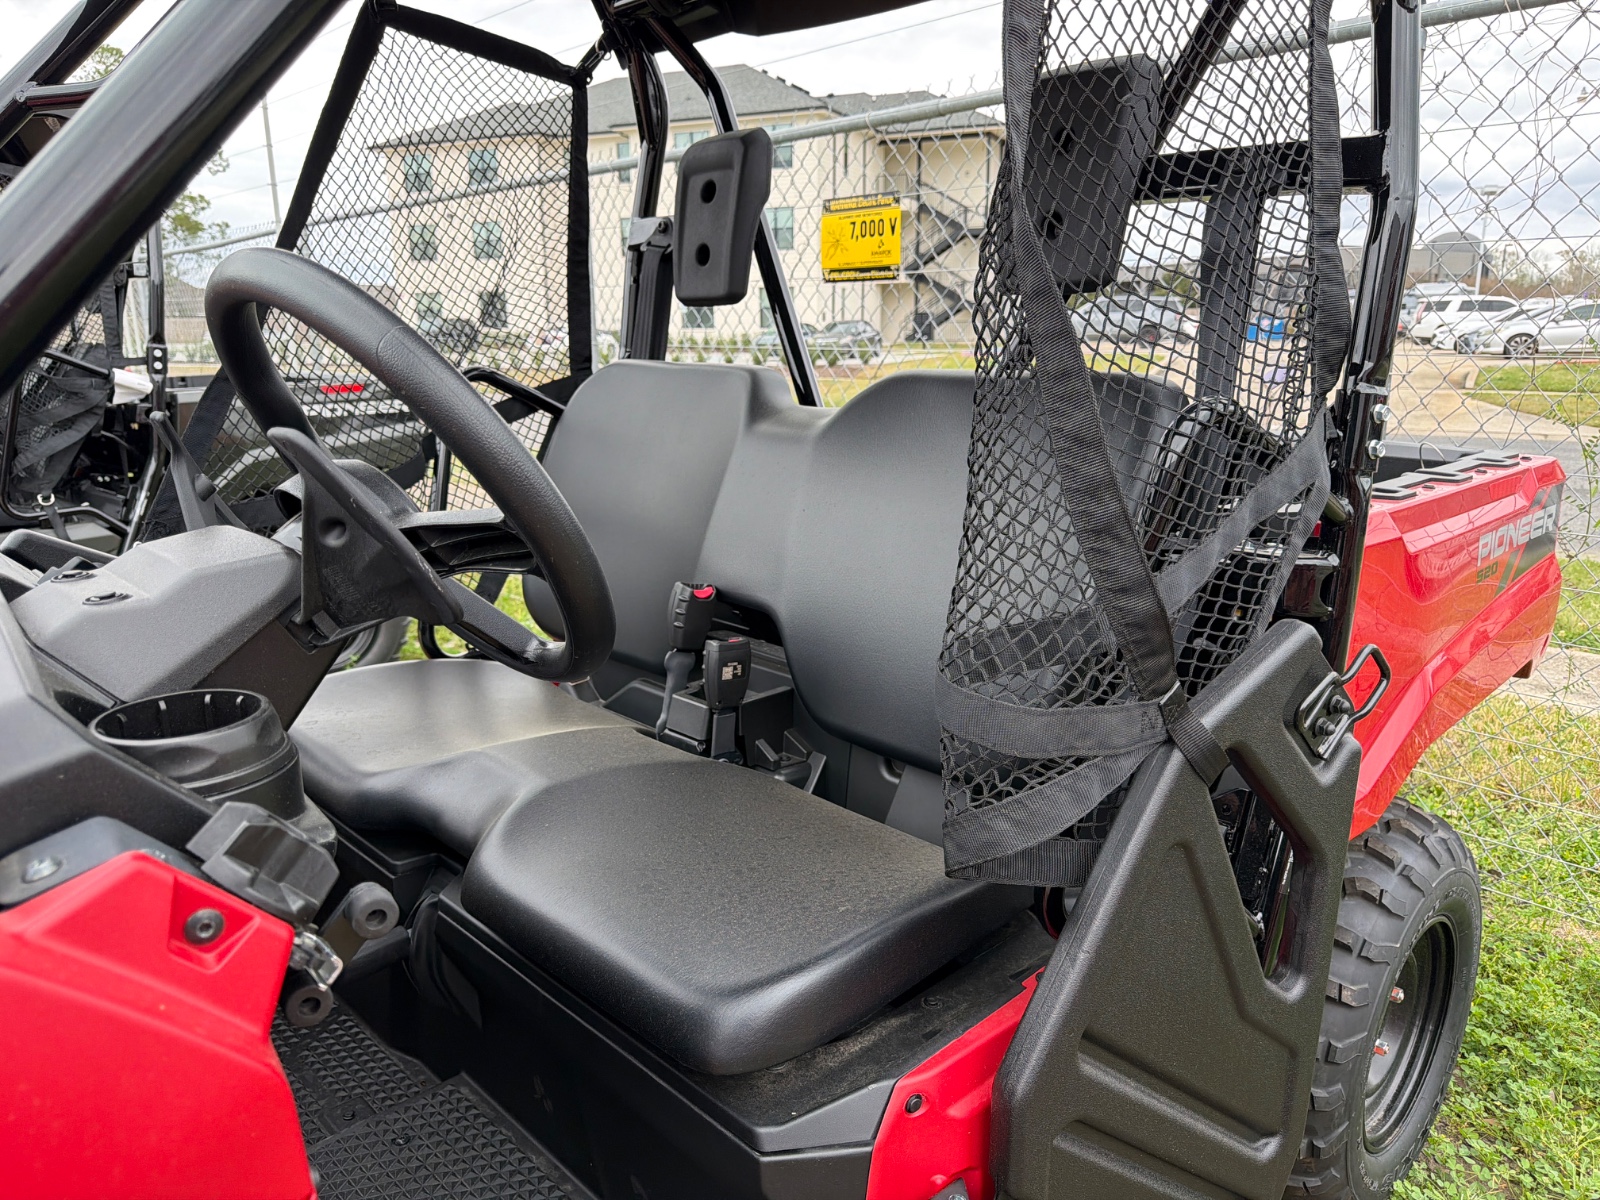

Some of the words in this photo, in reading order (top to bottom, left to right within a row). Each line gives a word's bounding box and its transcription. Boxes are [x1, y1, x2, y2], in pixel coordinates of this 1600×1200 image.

[850, 218, 885, 242] 7,000
[889, 217, 898, 236] V
[1477, 505, 1557, 566] PIONEER
[1476, 561, 1499, 584] 520
